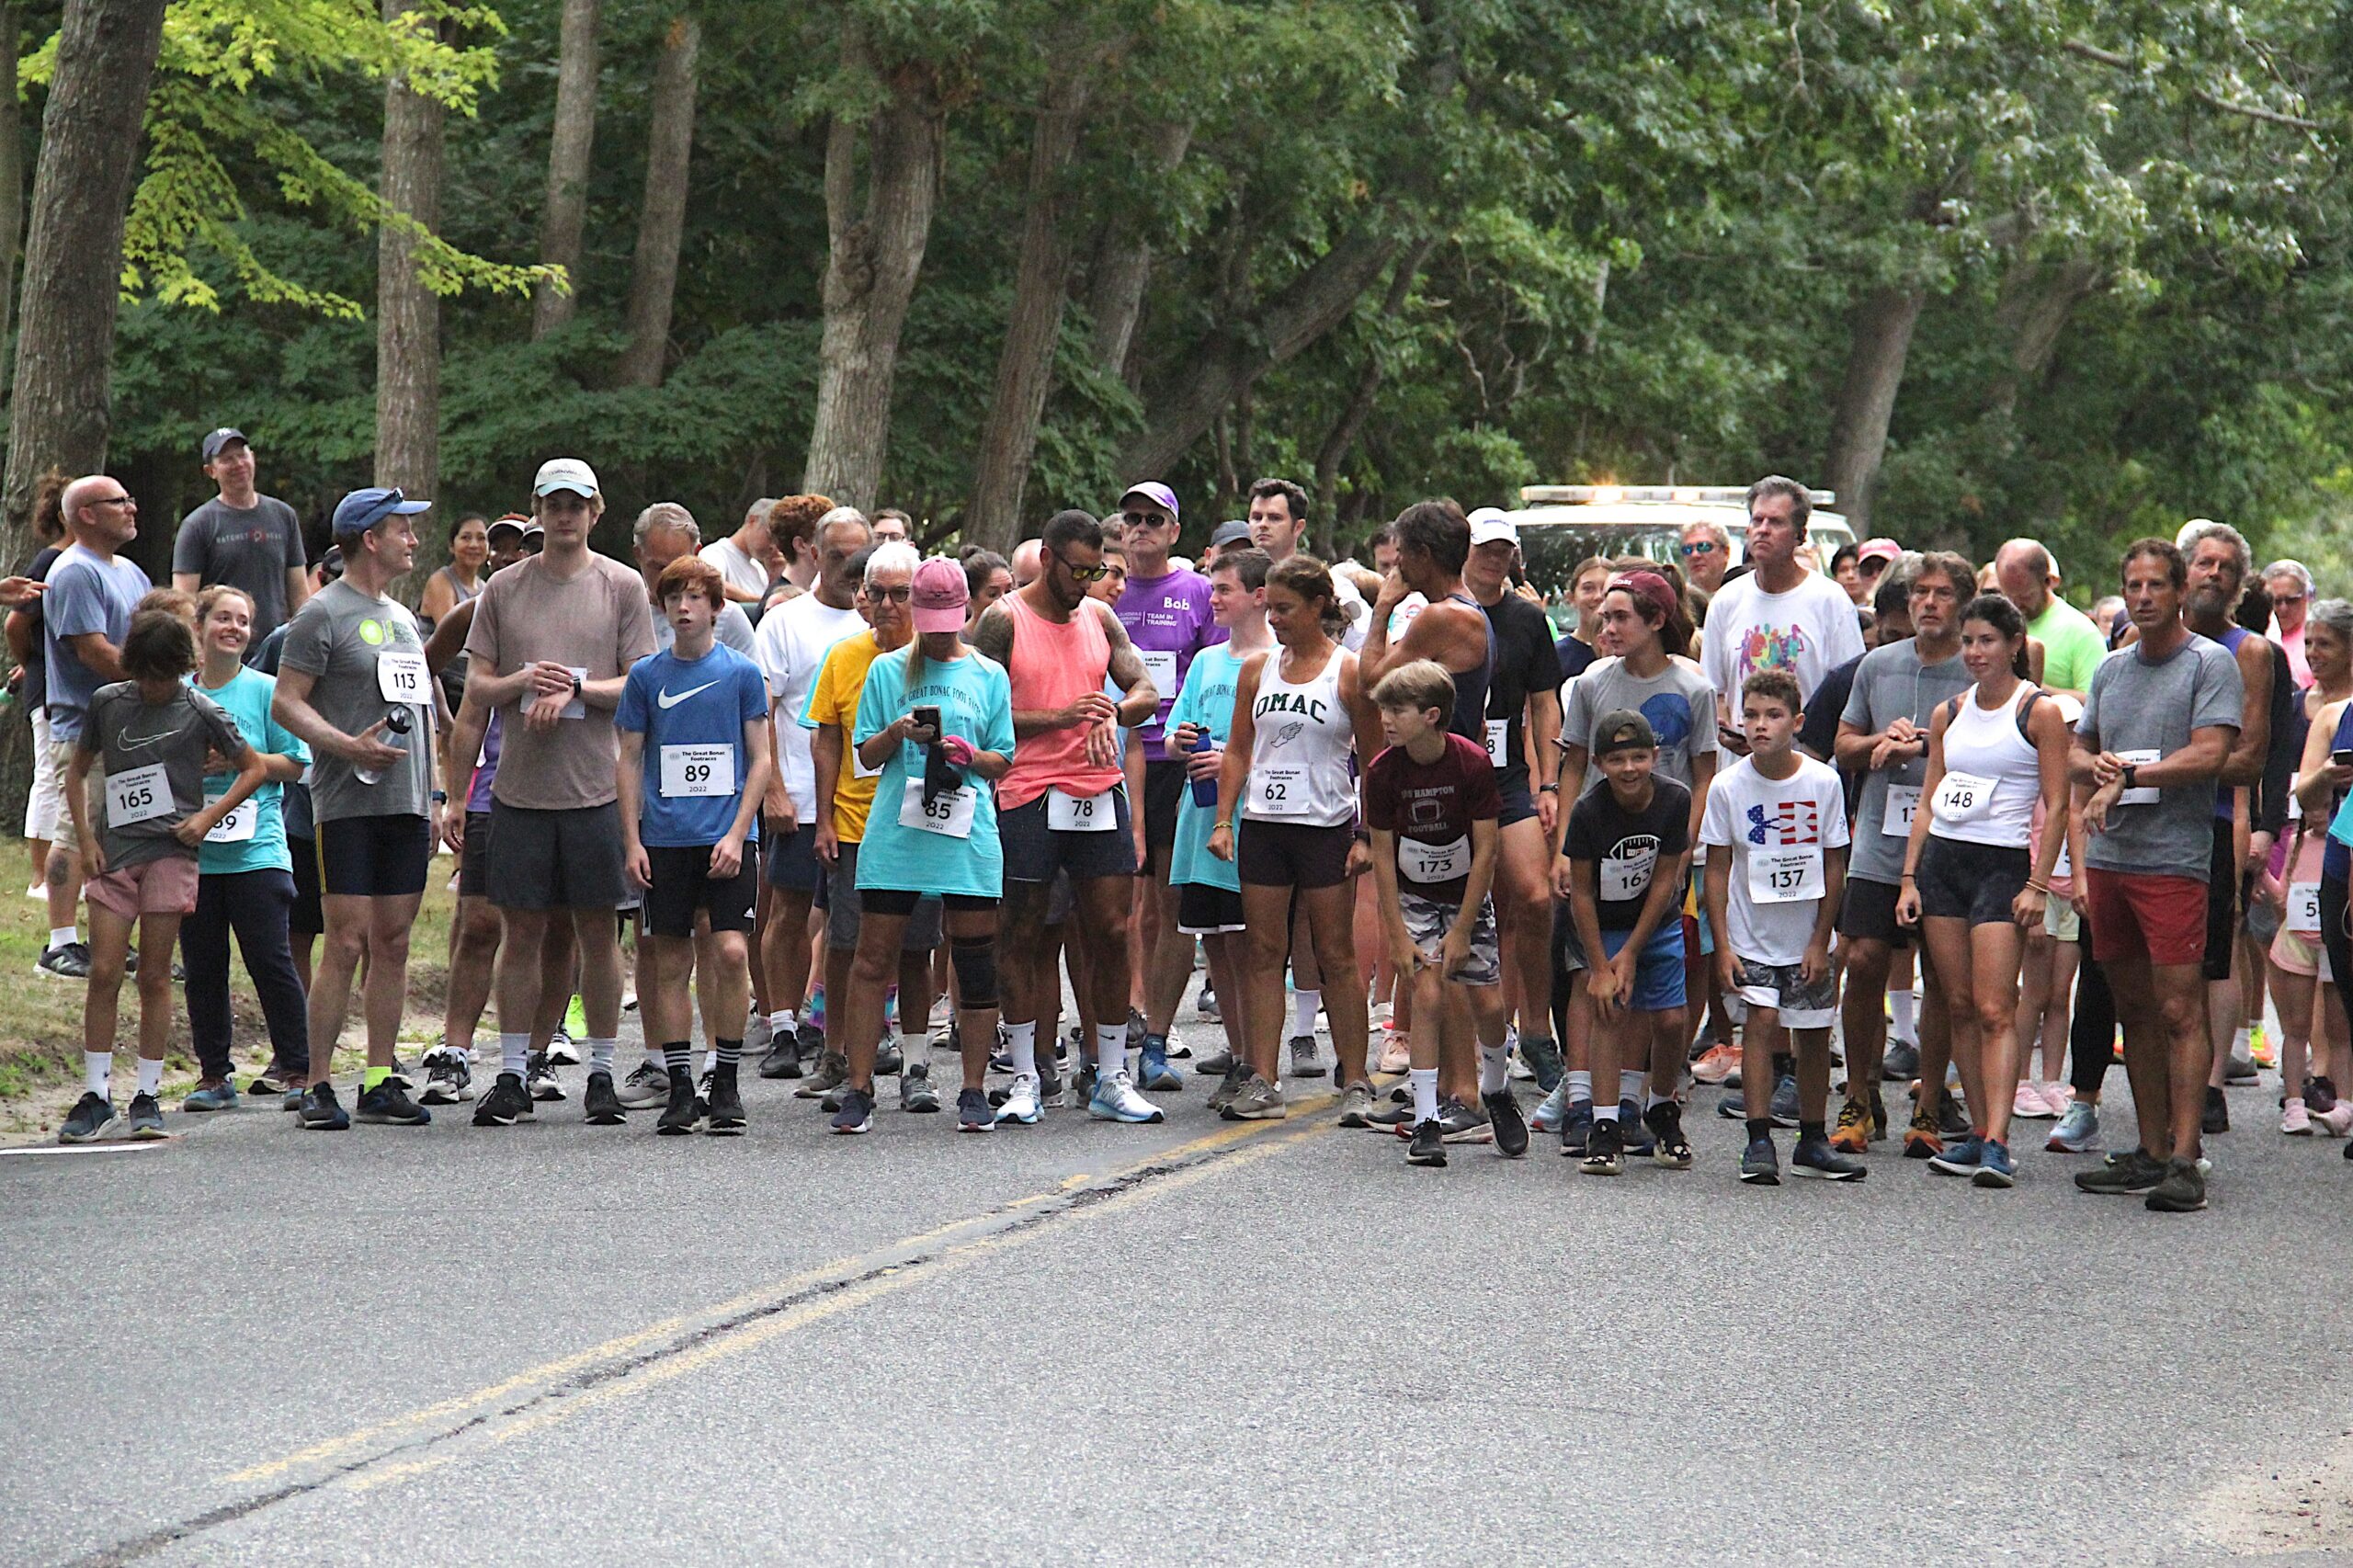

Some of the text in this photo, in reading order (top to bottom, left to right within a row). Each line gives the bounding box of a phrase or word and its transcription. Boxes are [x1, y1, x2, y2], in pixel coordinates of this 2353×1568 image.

[1164, 597, 1189, 610] Bob
[393, 673, 415, 689] 113
[897, 694, 906, 710] THE
[908, 686, 926, 701] GREAT
[930, 686, 950, 697] BONAC
[952, 687, 966, 703] FOOT
[685, 765, 710, 782] 89
[119, 788, 153, 810] 165
[1265, 784, 1286, 800] 62
[1944, 791, 1973, 807] 148
[131, 810, 147, 819] 2022
[926, 801, 951, 820] 85
[1072, 800, 1093, 816] 78
[926, 822, 944, 830] 2022
[1418, 858, 1452, 873] 173
[1621, 868, 1651, 889] 163
[1770, 869, 1803, 888] 137
